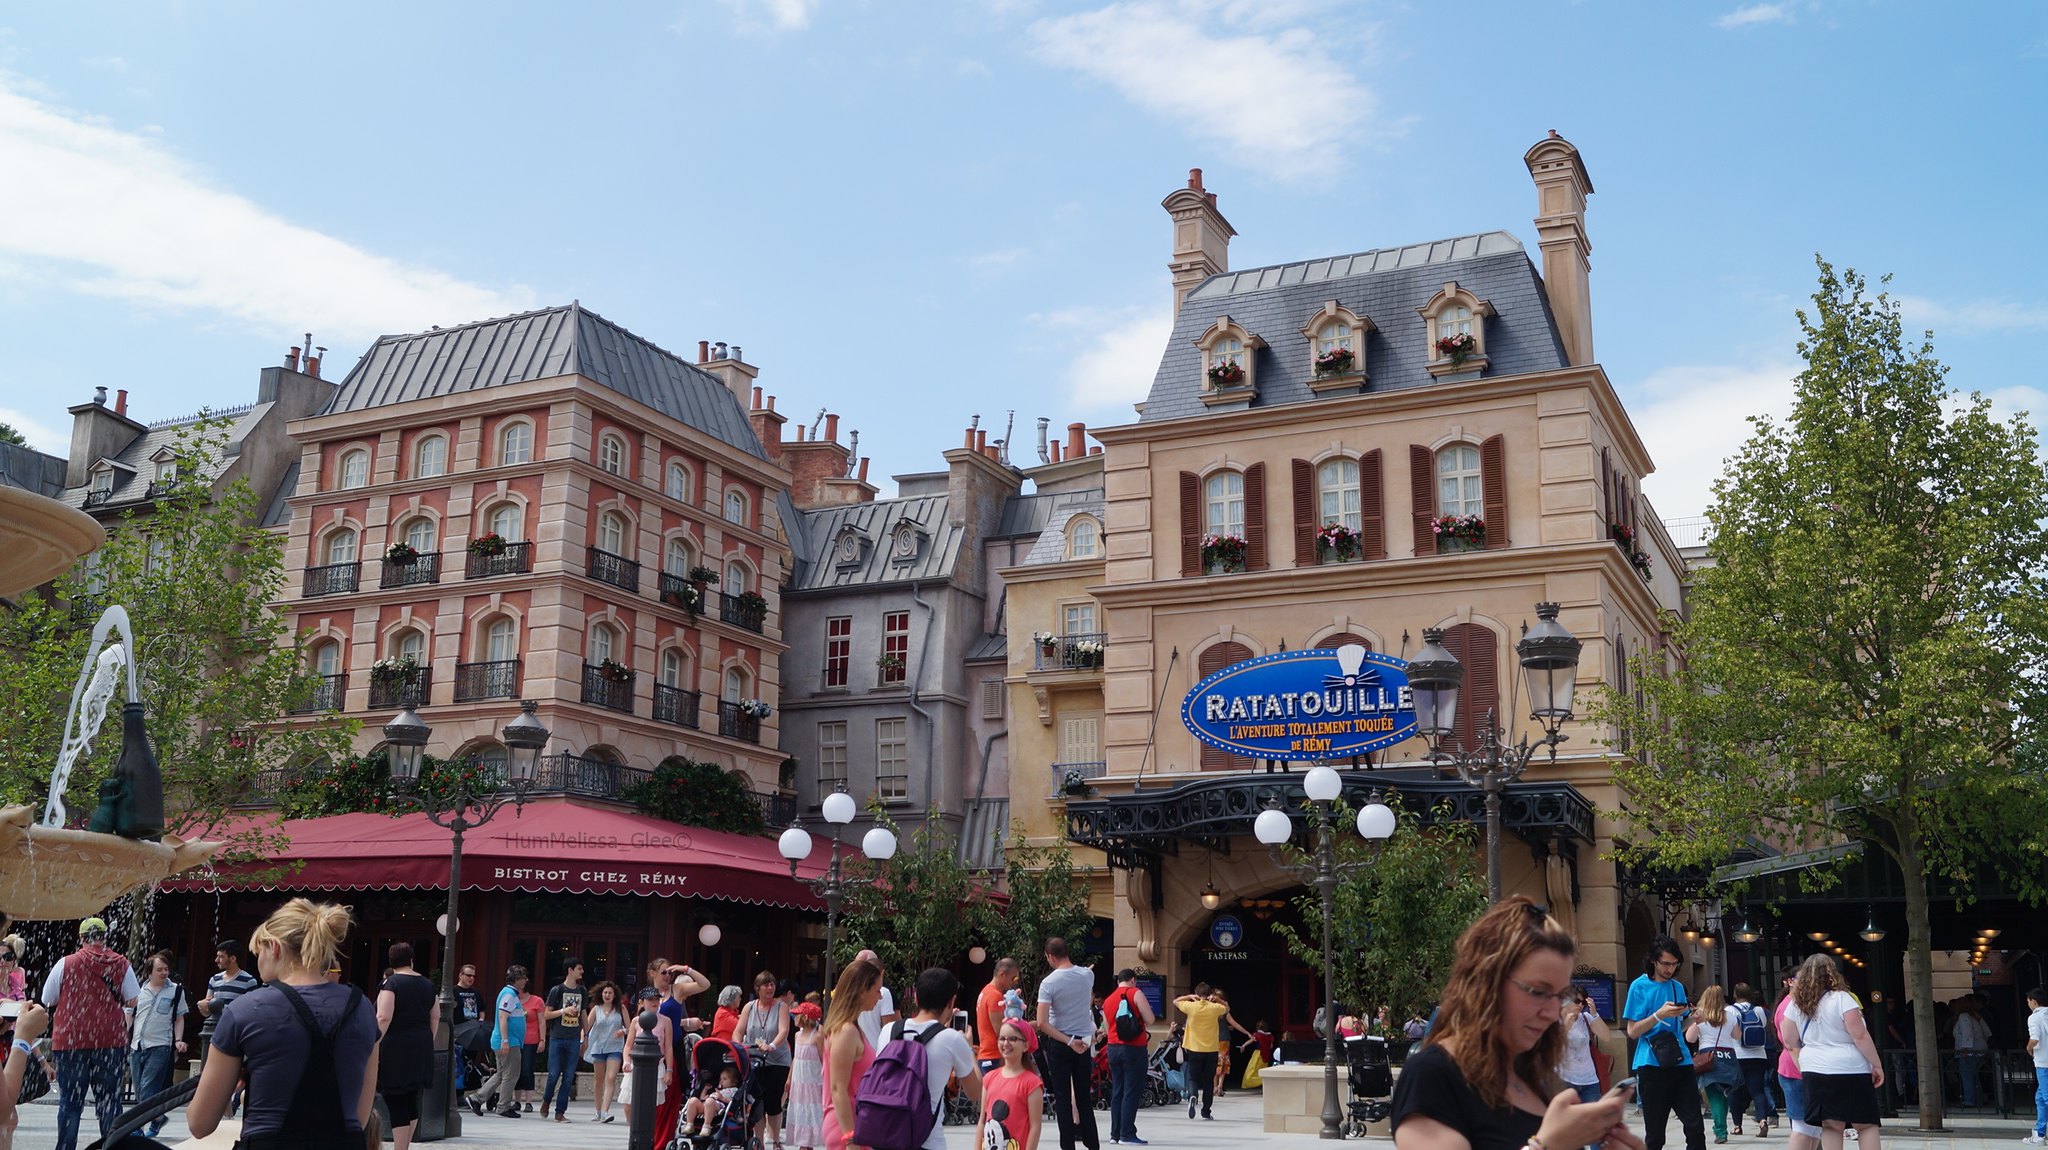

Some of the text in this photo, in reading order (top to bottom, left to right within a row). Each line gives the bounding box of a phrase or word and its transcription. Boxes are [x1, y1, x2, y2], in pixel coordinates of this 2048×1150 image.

[1206, 685, 1413, 722] RATATOUILLE
[1229, 714, 1394, 740] L'AVENTURE TOTALEMENT TOQUÉE
[1291, 736, 1332, 752] DE RÉMY
[494, 868, 687, 886] BISTROT CHEZ RÉMY
[1208, 951, 1248, 960] FASTPASS
